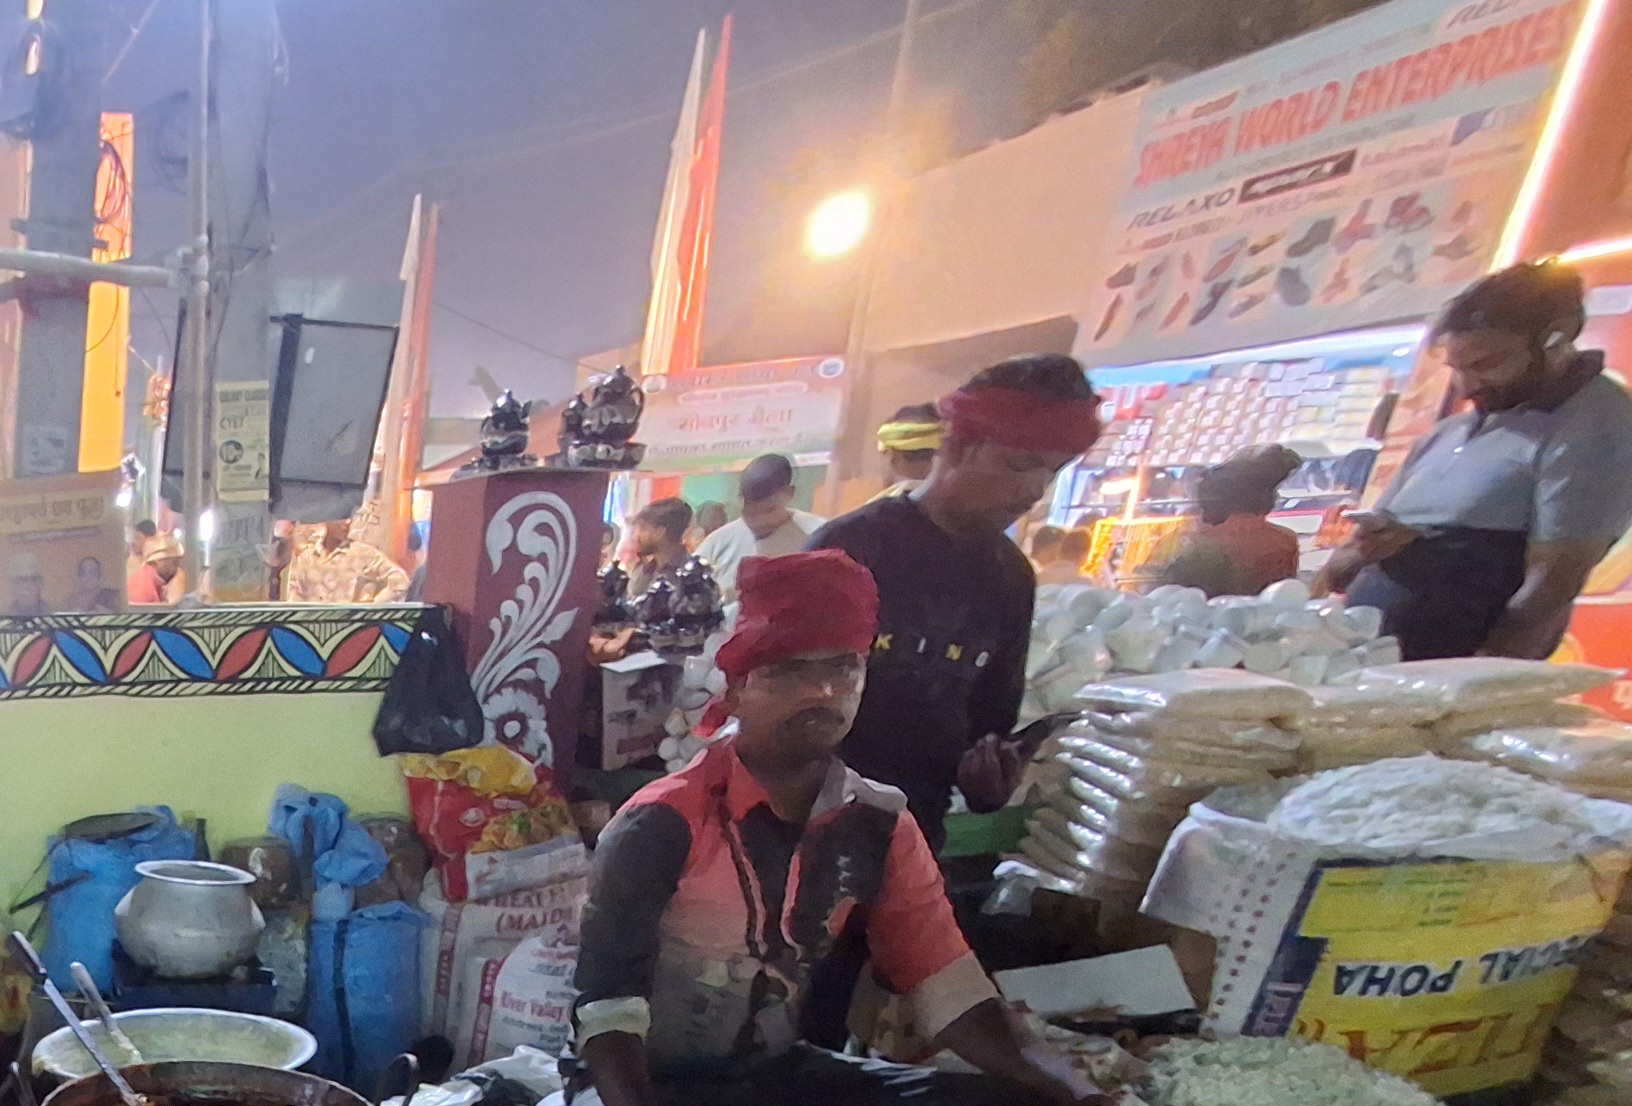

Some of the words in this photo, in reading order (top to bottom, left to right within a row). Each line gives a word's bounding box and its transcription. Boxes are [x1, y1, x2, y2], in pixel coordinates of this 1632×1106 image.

[1234, 79, 1340, 156] WORLD
[1126, 187, 1236, 231] RELAXO
[1333, 954, 1465, 998] POHA
